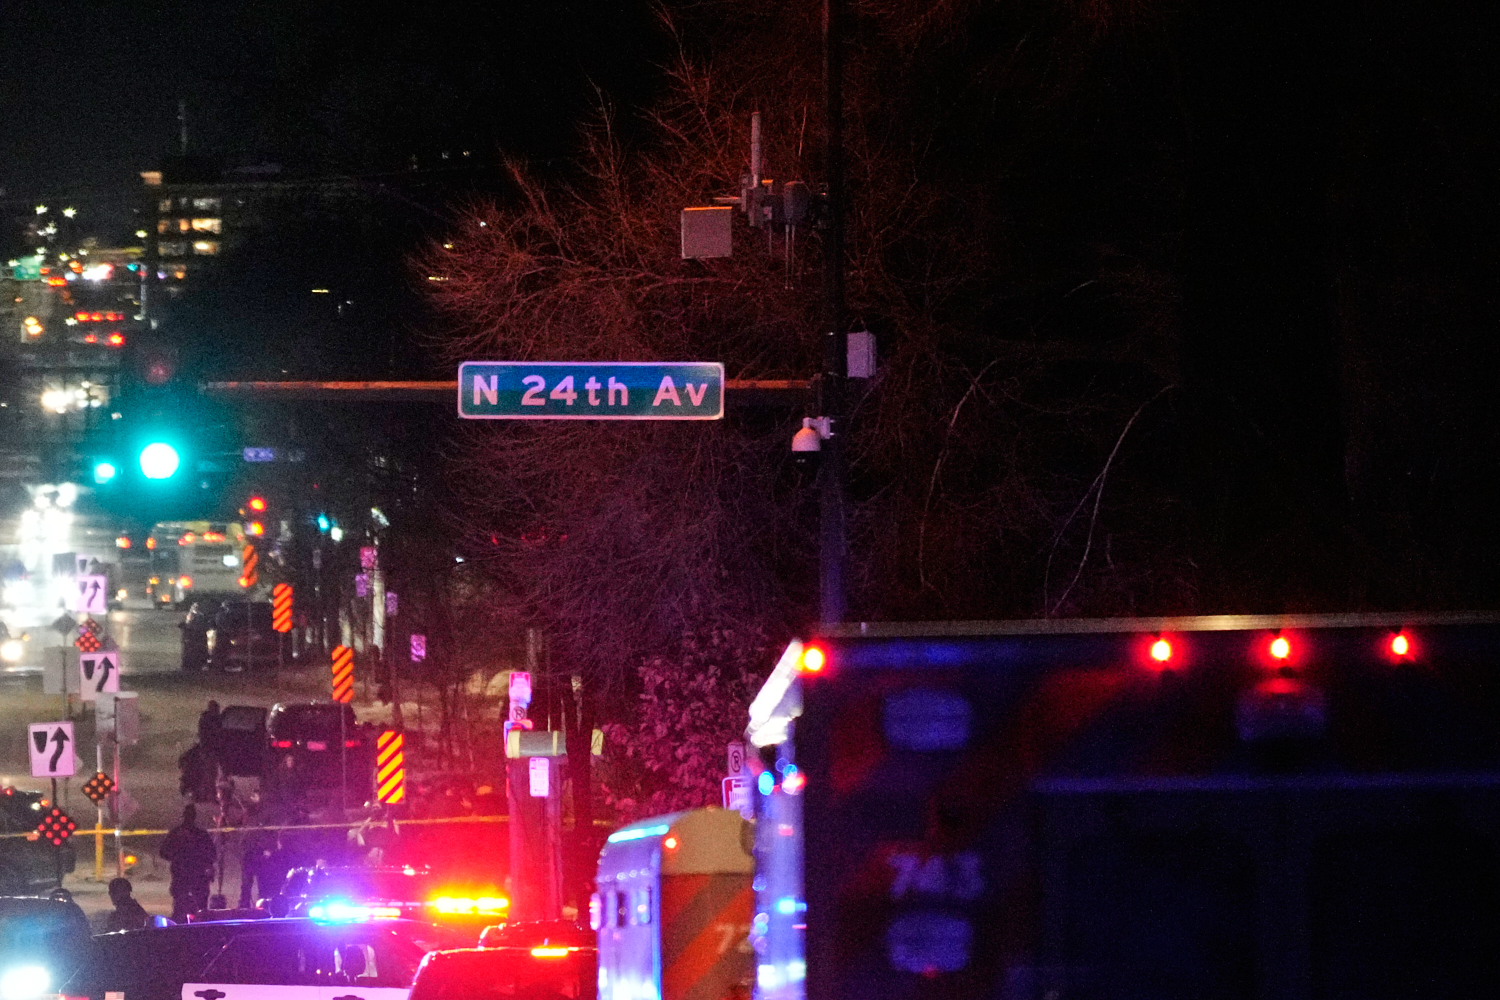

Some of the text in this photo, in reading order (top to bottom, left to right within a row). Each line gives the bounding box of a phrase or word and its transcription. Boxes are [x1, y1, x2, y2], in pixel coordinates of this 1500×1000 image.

[473, 375, 708, 407] N 24th Av
